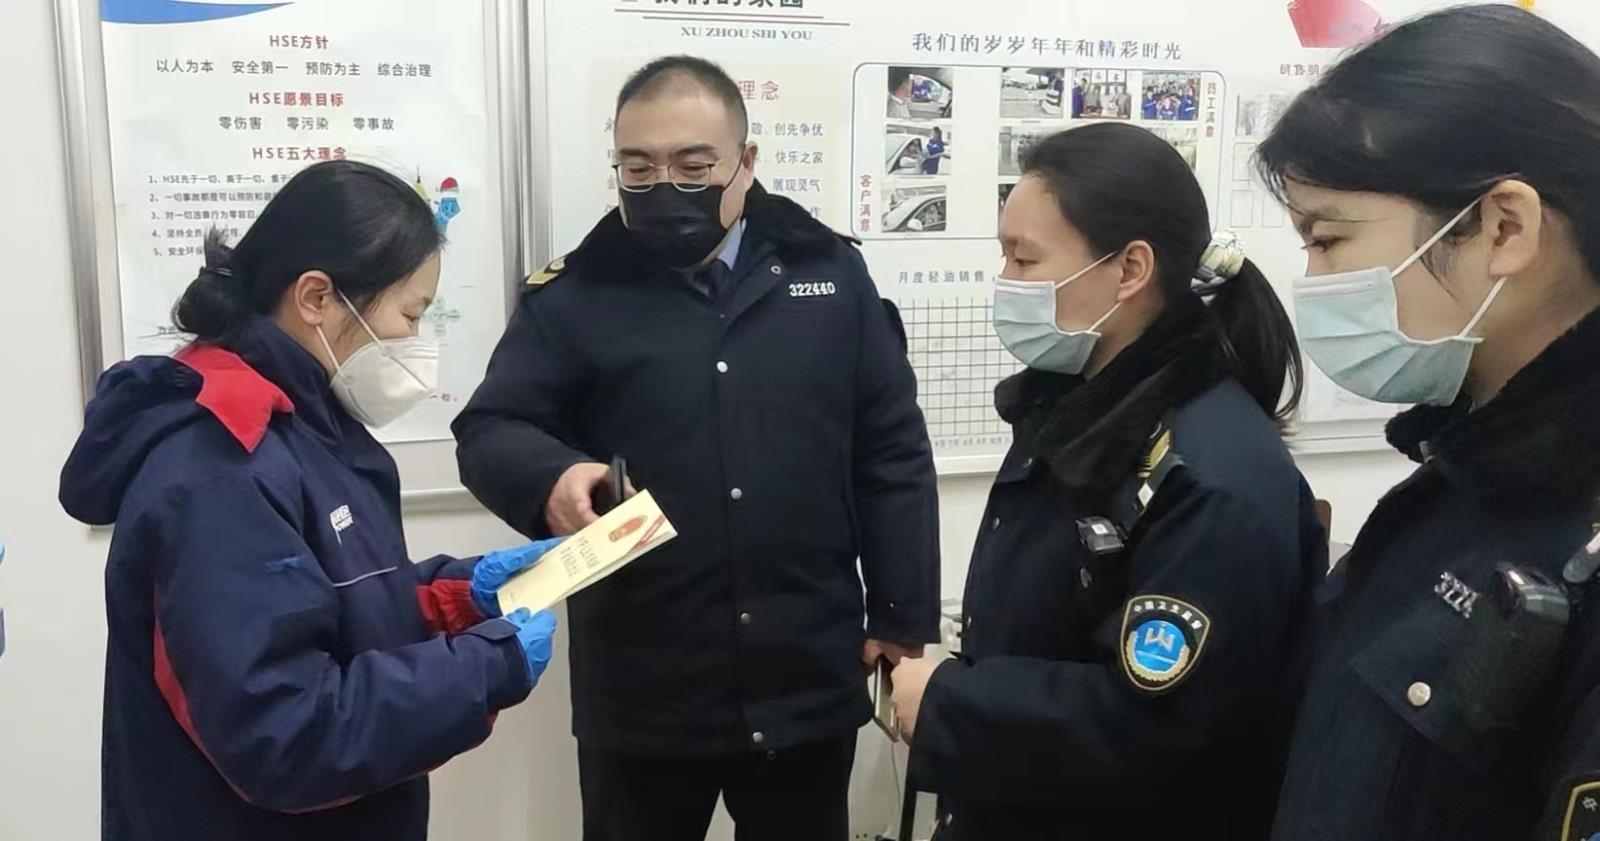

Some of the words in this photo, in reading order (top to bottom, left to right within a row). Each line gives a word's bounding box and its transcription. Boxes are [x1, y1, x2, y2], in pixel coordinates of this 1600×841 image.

[680, 26, 702, 37] XU
[705, 27, 750, 39] ZHOU
[751, 29, 777, 39] SHI
[780, 30, 814, 41] YOU
[269, 34, 329, 50] HSE方针
[912, 32, 1182, 61] 我们的岁岁年年和精彩时光
[156, 59, 214, 74] 以人为本
[231, 60, 289, 75] 安全第一
[305, 62, 361, 76] 预防为主
[377, 63, 432, 77] 综合治理
[249, 91, 344, 107] HSE愿景目标
[219, 116, 263, 131] 零伤害
[286, 117, 329, 131] 零污染
[353, 118, 395, 131] 零事故
[252, 147, 347, 161] HSE五大理念
[898, 270, 996, 284] 月度轻油销售
[788, 281, 836, 297] 322440
